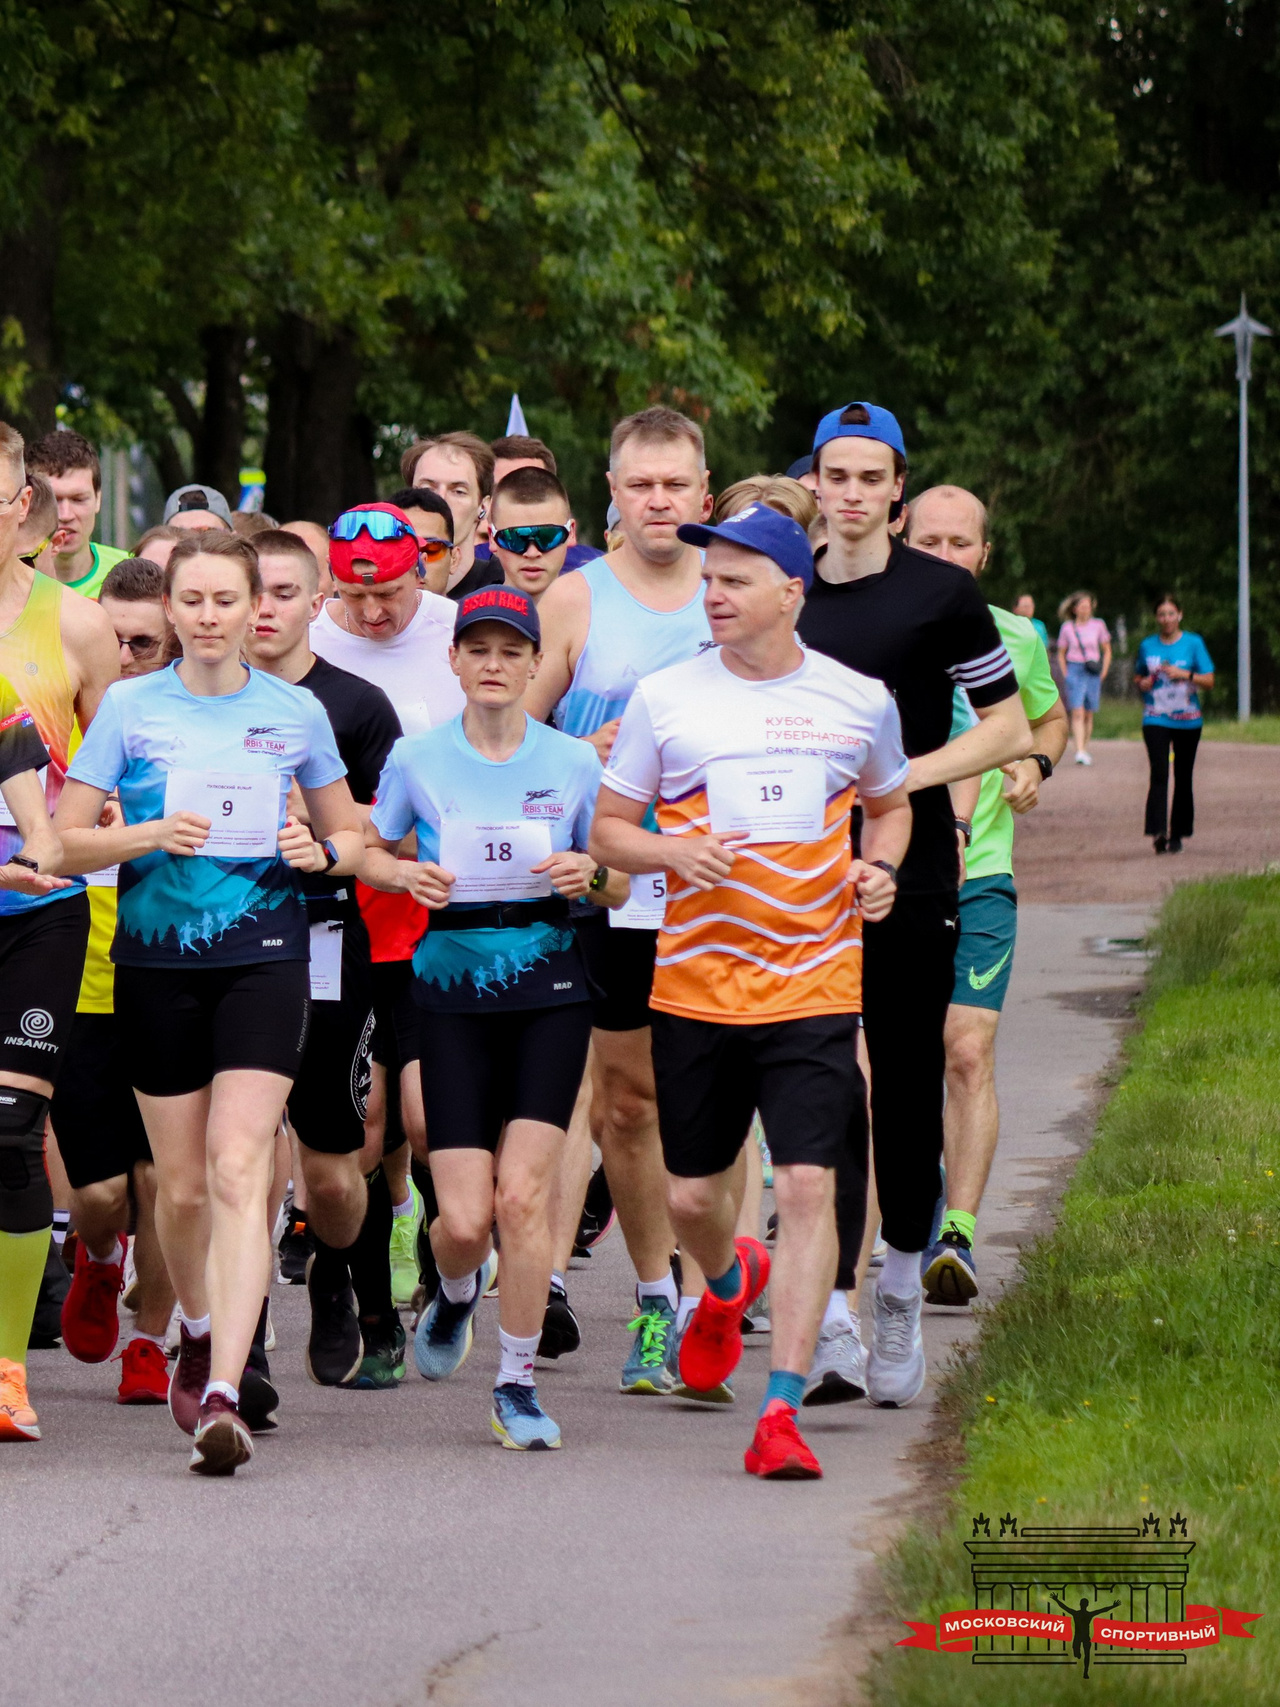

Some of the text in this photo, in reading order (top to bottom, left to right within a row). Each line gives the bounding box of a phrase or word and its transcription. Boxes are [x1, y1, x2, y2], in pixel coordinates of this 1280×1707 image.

[498, 590, 529, 617] RACE
[765, 717, 814, 727] КУБОК
[243, 738, 285, 753] IRBIS TEAM
[766, 730, 861, 748] ГУБЕРНАТОРА
[760, 785, 783, 802] 19
[222, 800, 234, 817] 9
[522, 804, 564, 815] IRBIS TEAM
[484, 842, 512, 862] 18
[262, 939, 283, 948] MAD
[553, 981, 573, 991] MAD
[3, 1036, 59, 1054] INSANITY
